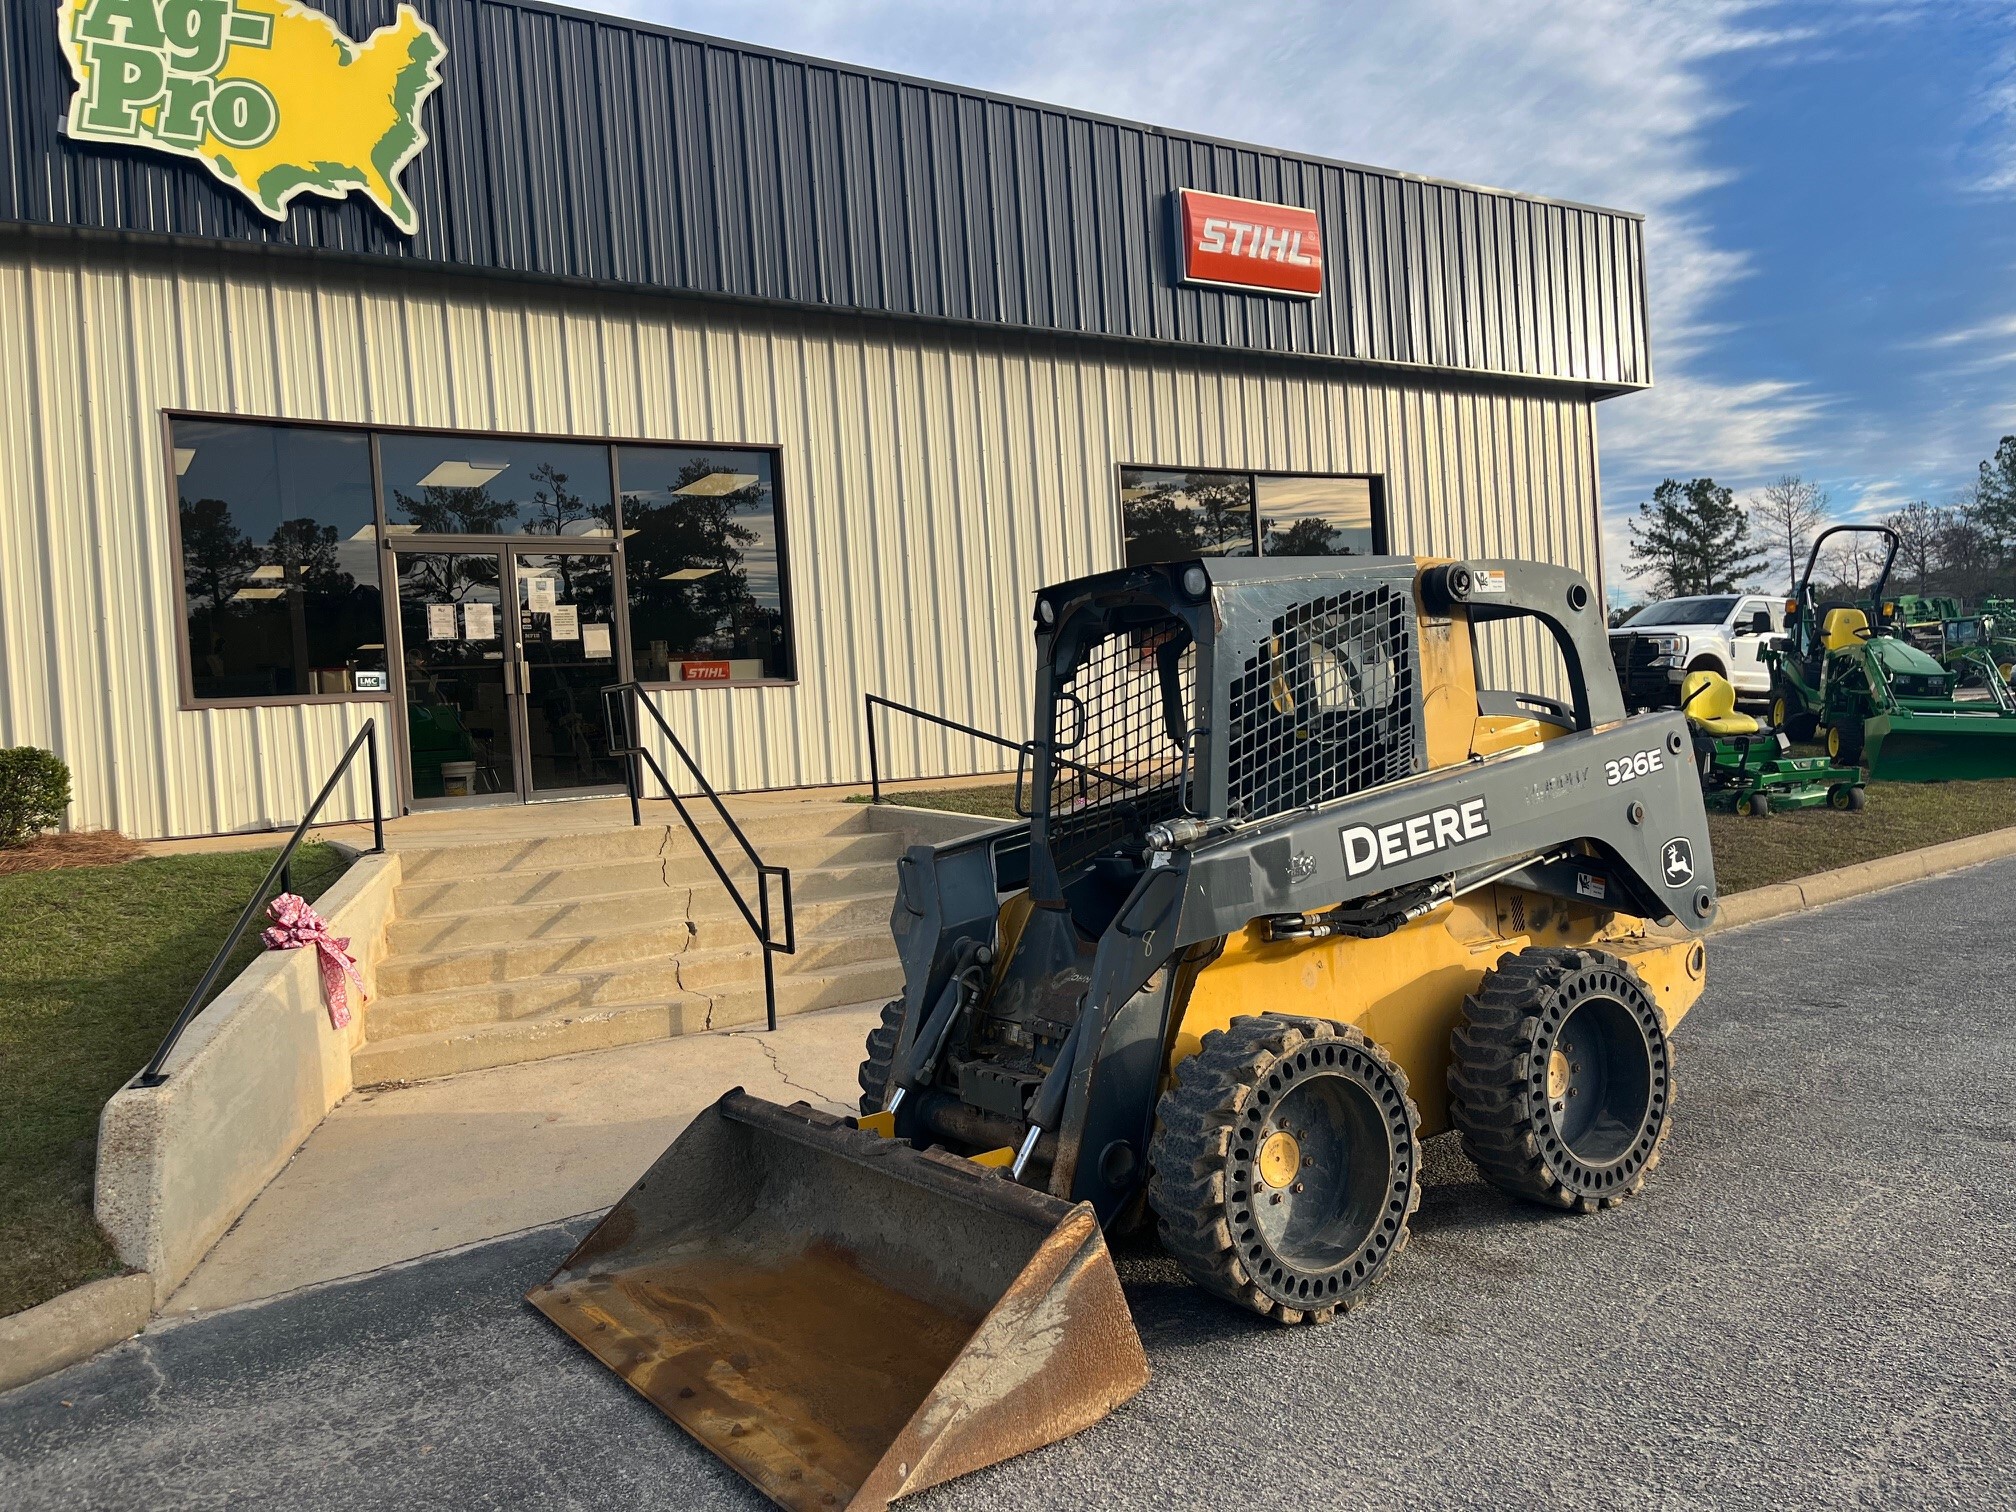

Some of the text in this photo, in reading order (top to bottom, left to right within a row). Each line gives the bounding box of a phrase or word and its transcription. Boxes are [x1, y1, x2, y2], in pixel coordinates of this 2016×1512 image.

[72, 0, 275, 76] Ag-
[79, 42, 280, 148] Pro
[1199, 217, 1312, 266] STIHL
[360, 677, 378, 685] LMC
[687, 667, 726, 678] STIHL
[1604, 747, 1664, 786] 326E
[1340, 796, 1490, 878] DEERE
[1142, 930, 1156, 957] 8
